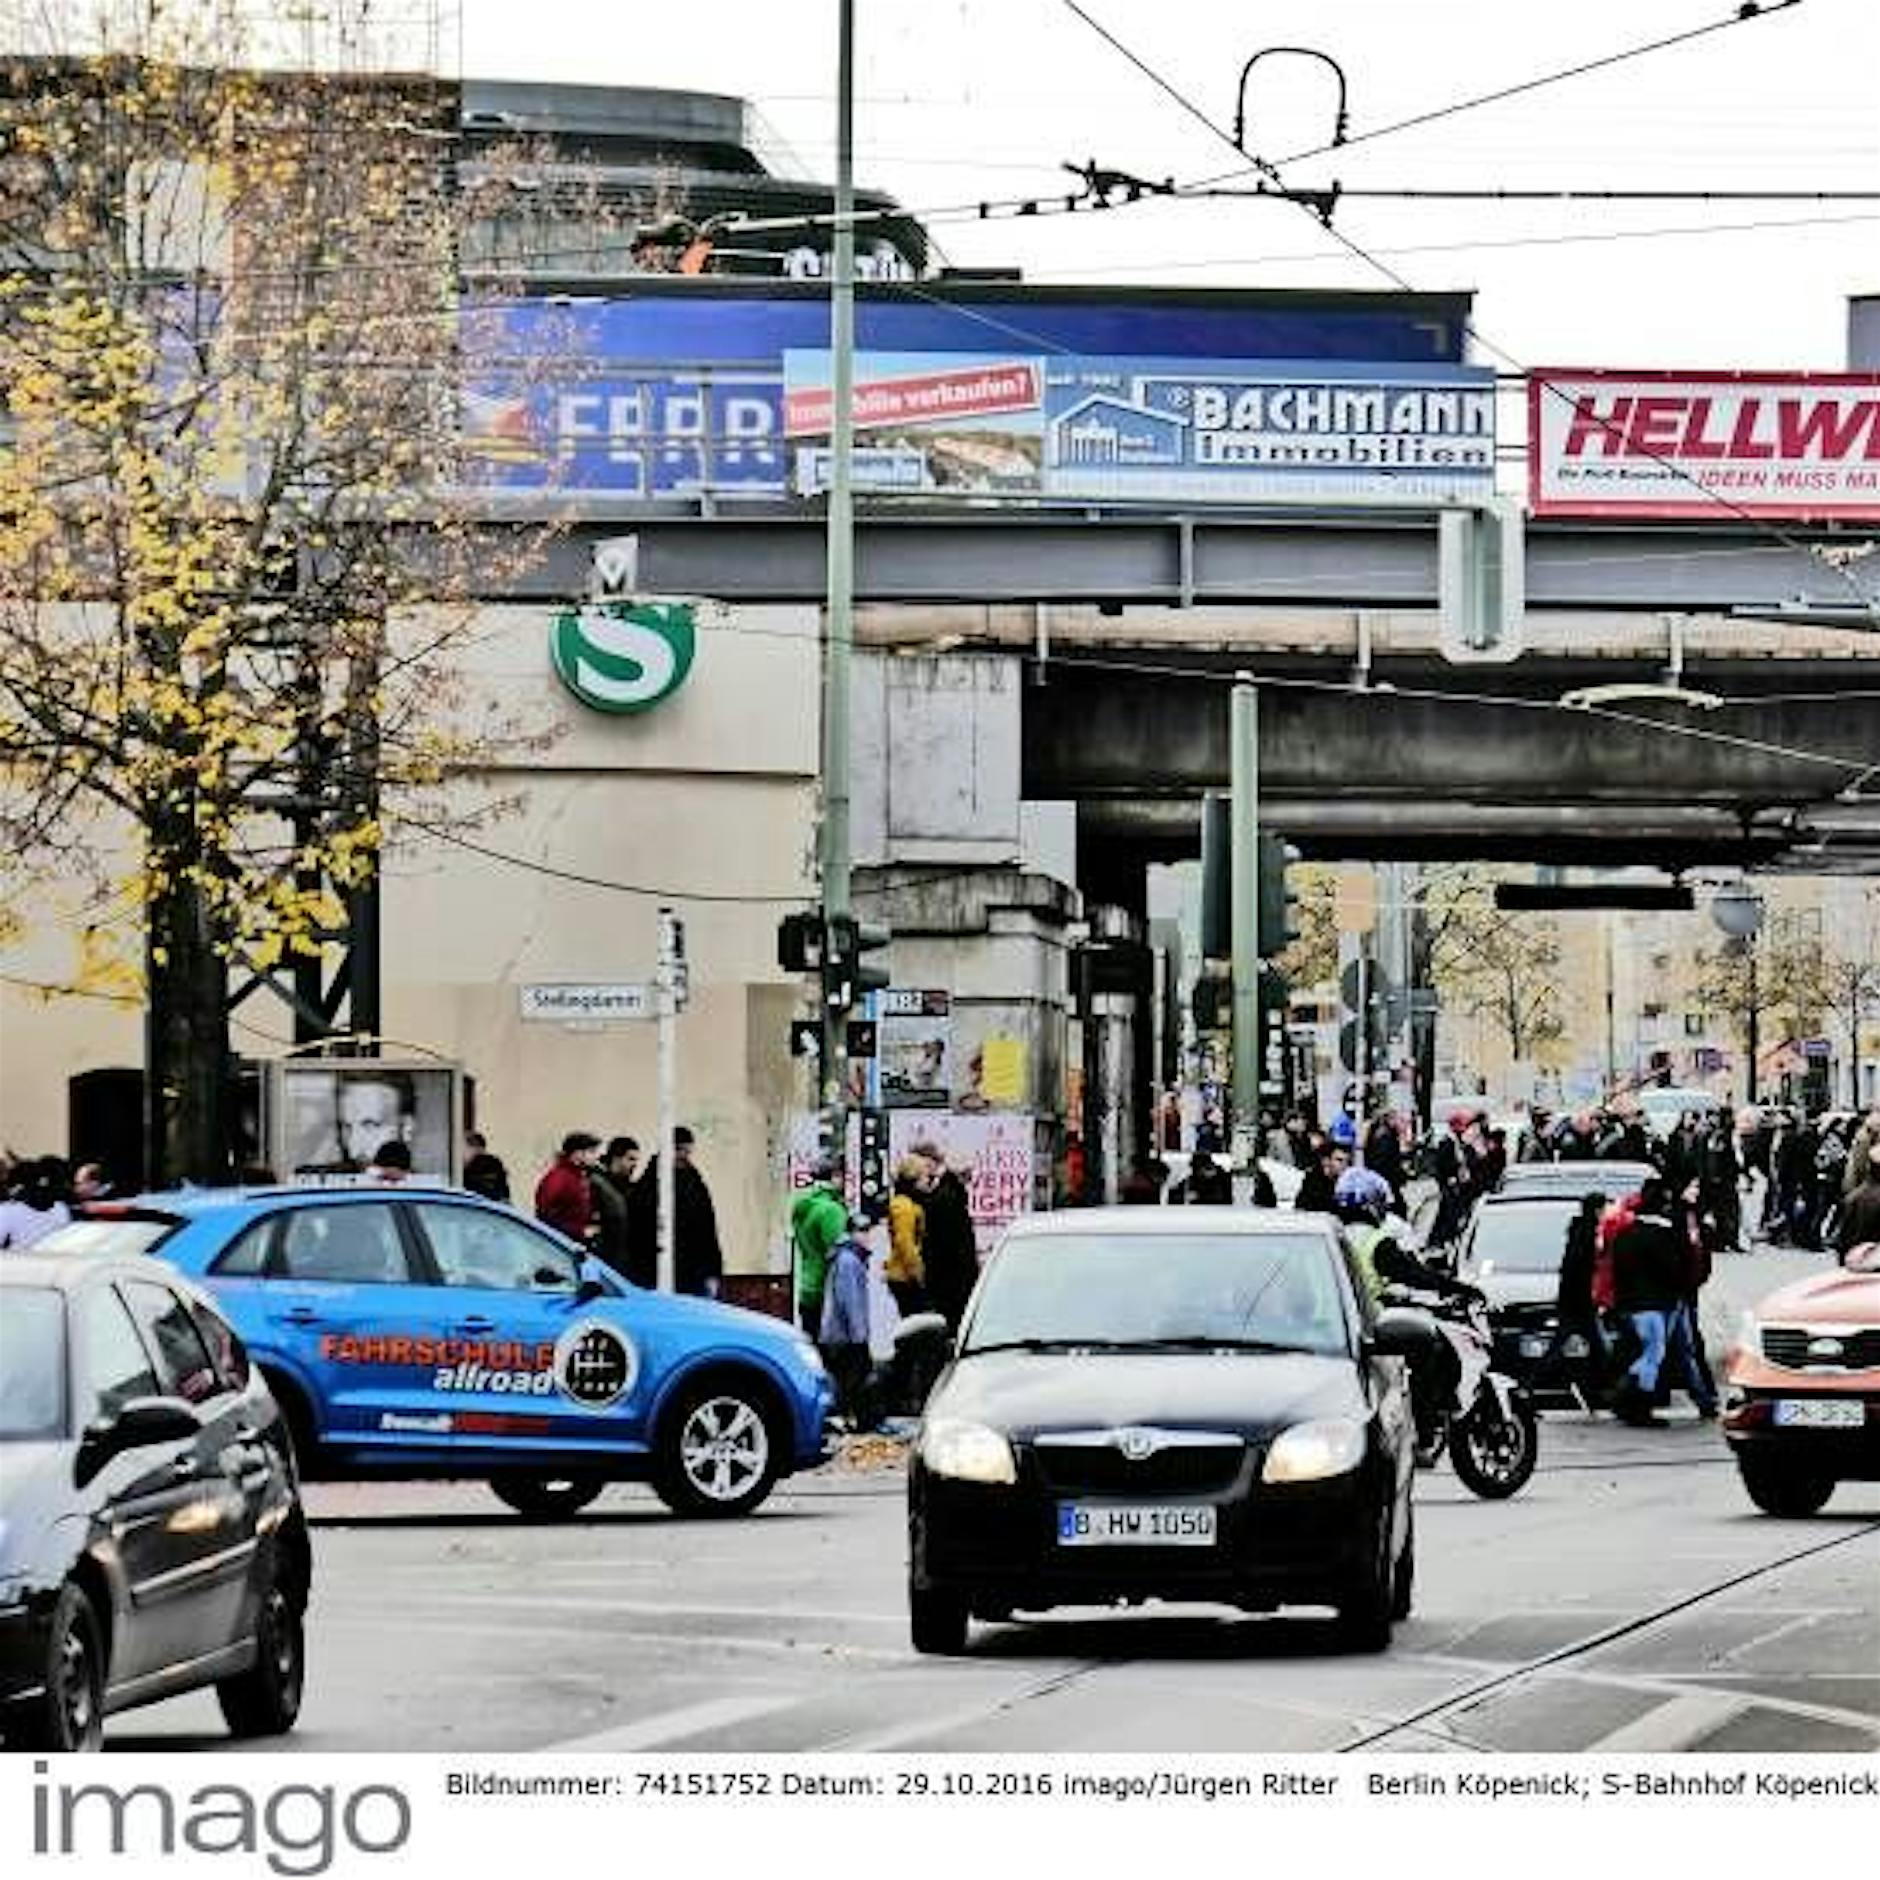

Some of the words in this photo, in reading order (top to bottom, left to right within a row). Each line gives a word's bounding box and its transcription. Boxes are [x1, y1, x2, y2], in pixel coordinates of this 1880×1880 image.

[904, 369, 1026, 408] verkaufen?
[1194, 386, 1491, 434] BACHMANN
[1774, 471, 1837, 490] MUSS
[320, 1333, 554, 1370] FAHRSCHULE
[433, 1362, 555, 1395] allroad
